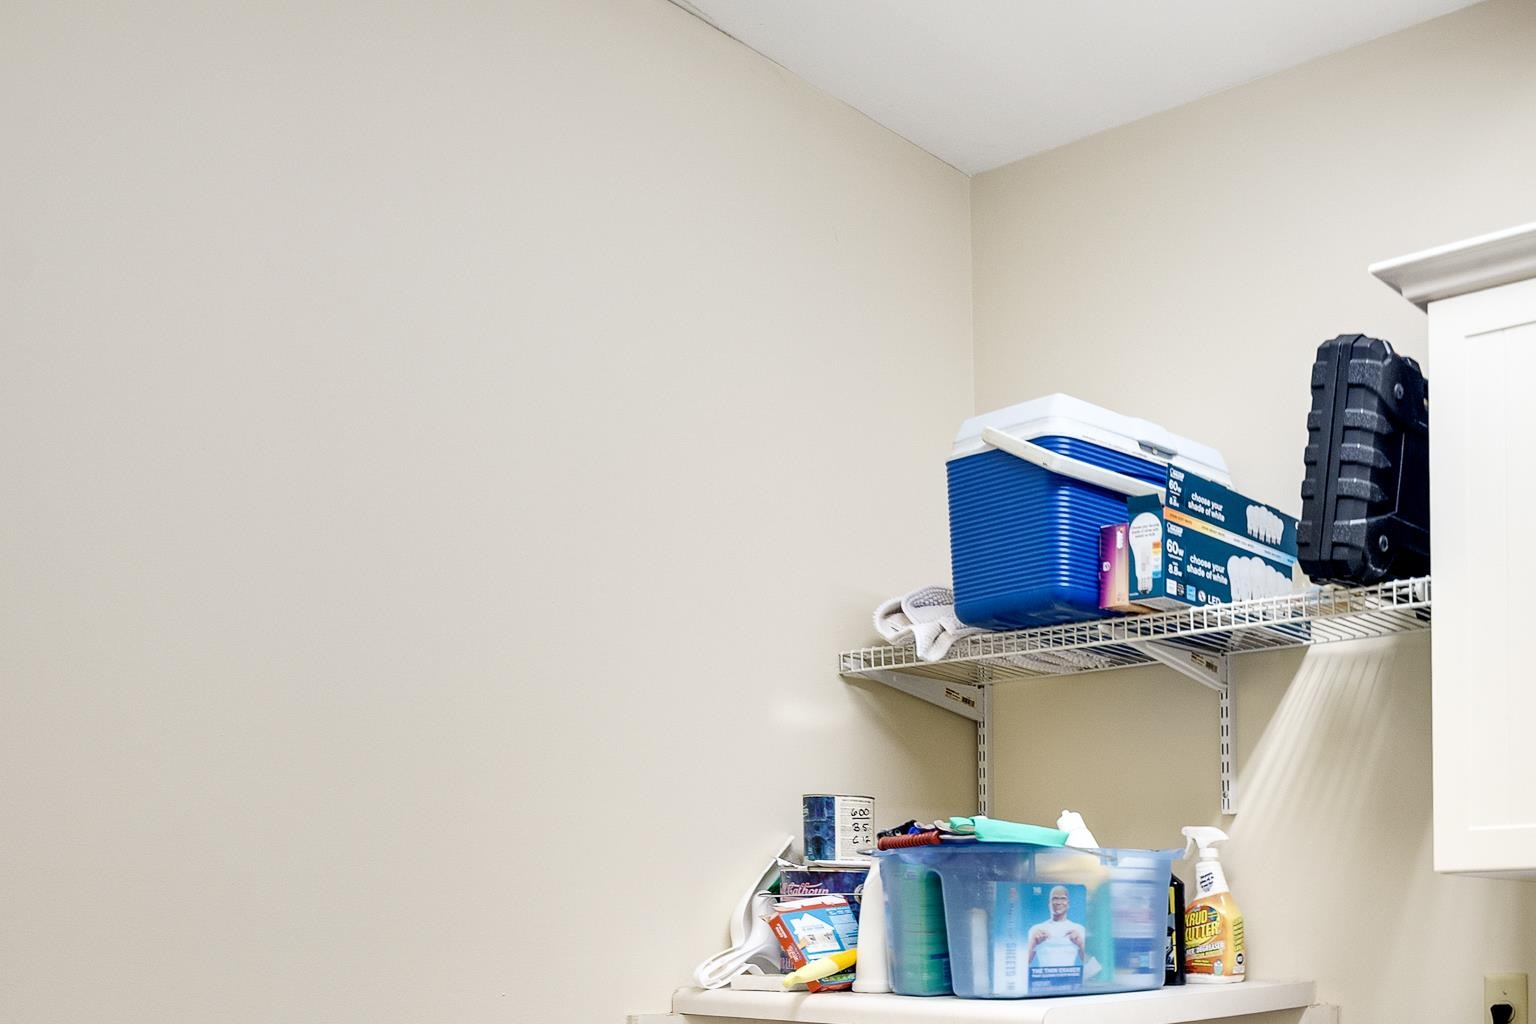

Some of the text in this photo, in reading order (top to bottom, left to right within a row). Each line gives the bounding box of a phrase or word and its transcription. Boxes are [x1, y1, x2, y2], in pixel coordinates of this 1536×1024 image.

[1187, 500, 1205, 514] shade
[1211, 510, 1225, 522] white
[1191, 492, 1223, 512] choose your
[1186, 563, 1206, 578] shade
[1212, 573, 1228, 586] white
[1189, 554, 1225, 574] choose your
